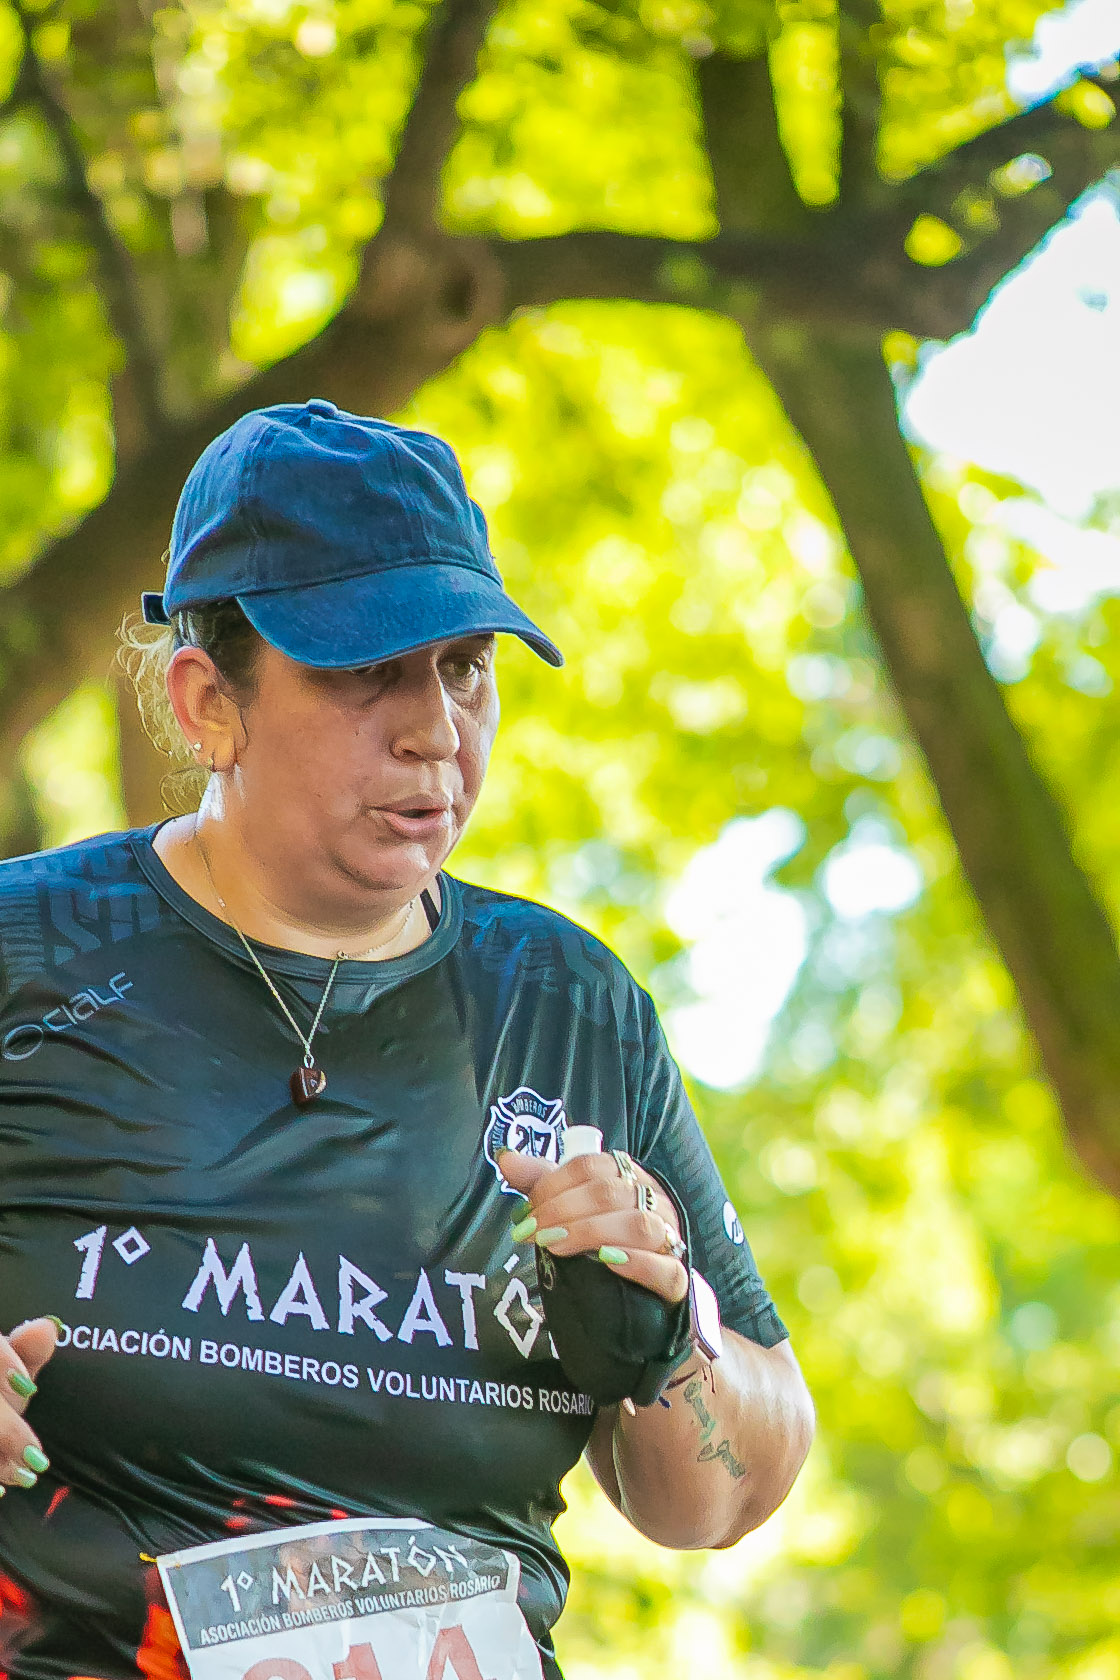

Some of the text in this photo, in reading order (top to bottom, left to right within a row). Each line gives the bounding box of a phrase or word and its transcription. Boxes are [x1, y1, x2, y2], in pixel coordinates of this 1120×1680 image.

[181, 1237, 560, 1360] MARATÓ
[55, 1323, 192, 1361] OCIACIÓN
[199, 1338, 360, 1389] BOMBEROS
[367, 1367, 534, 1410] VOLUNTARIOS
[270, 1534, 469, 1605] MARATÓN
[200, 1574, 501, 1646] ASOCIACIÓN BOMBEROS VOLUNTARIOS ROSARIO
